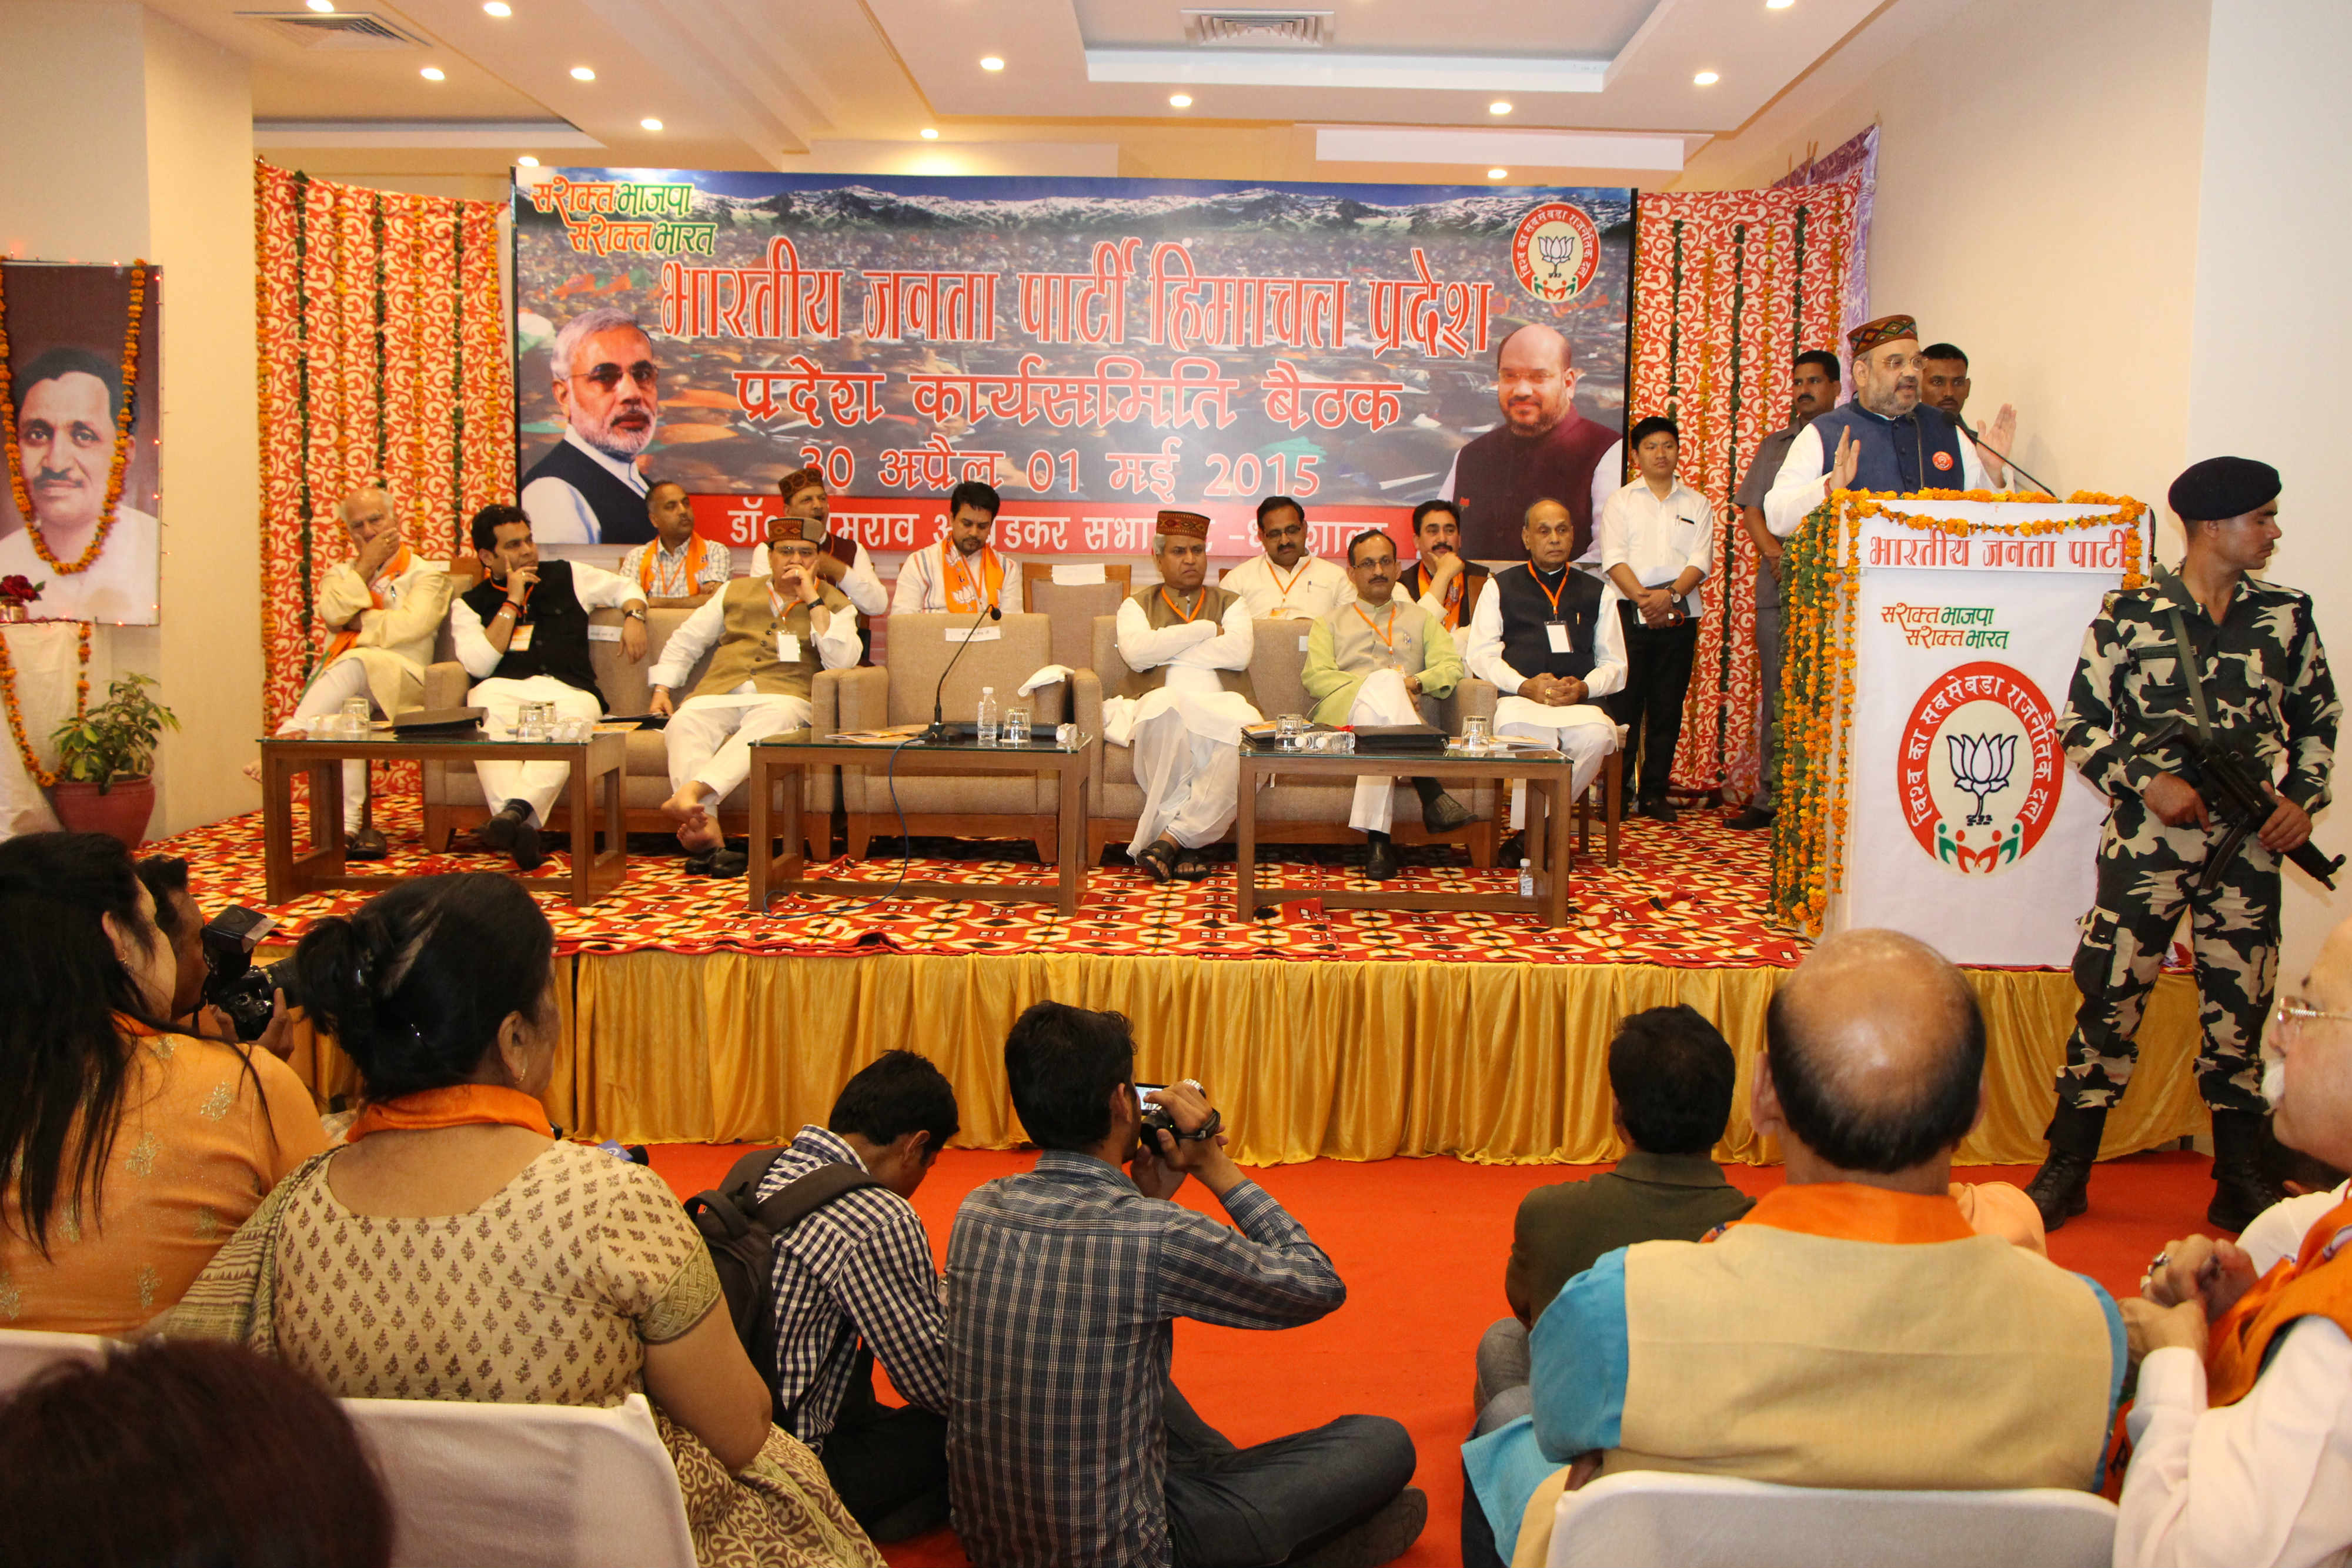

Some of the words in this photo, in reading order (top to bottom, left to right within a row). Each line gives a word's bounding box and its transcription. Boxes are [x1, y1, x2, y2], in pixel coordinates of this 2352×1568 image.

[532, 175, 616, 213] सशक्त
[617, 183, 693, 216] भाजपा
[569, 216, 653, 256] सशक्त
[654, 222, 717, 255] भारत
[661, 236, 844, 339] भारतीय
[862, 270, 1000, 342] जनता
[1017, 236, 1142, 345] पार्टी
[1148, 242, 1351, 351] हिमाचल
[1368, 247, 1494, 359] प्रदेश
[732, 355, 886, 427] प्रदेश
[908, 354, 1239, 429] कार्यसमिति
[1261, 359, 1404, 433] बैठक
[800, 446, 855, 489] 30
[878, 434, 1005, 490] अप्रैल
[1027, 449, 1080, 493] 01
[1105, 437, 1182, 503] मई
[1204, 452, 1321, 497] 2015
[826, 512, 920, 547] मराव
[1870, 528, 1972, 567] भारतीय
[1982, 539, 2057, 568] जनता
[2067, 527, 2130, 568] पाटी
[1882, 602, 1940, 626] सशक्त
[1940, 606, 1994, 627] भाजपा
[1905, 626, 1965, 649] सशक्त
[1966, 629, 2010, 649] भारत
[1907, 728, 1931, 760] का
[2007, 683, 2056, 782] राजनैतिक
[1907, 768, 1932, 827] विश्व
[2021, 787, 2049, 824] दल
